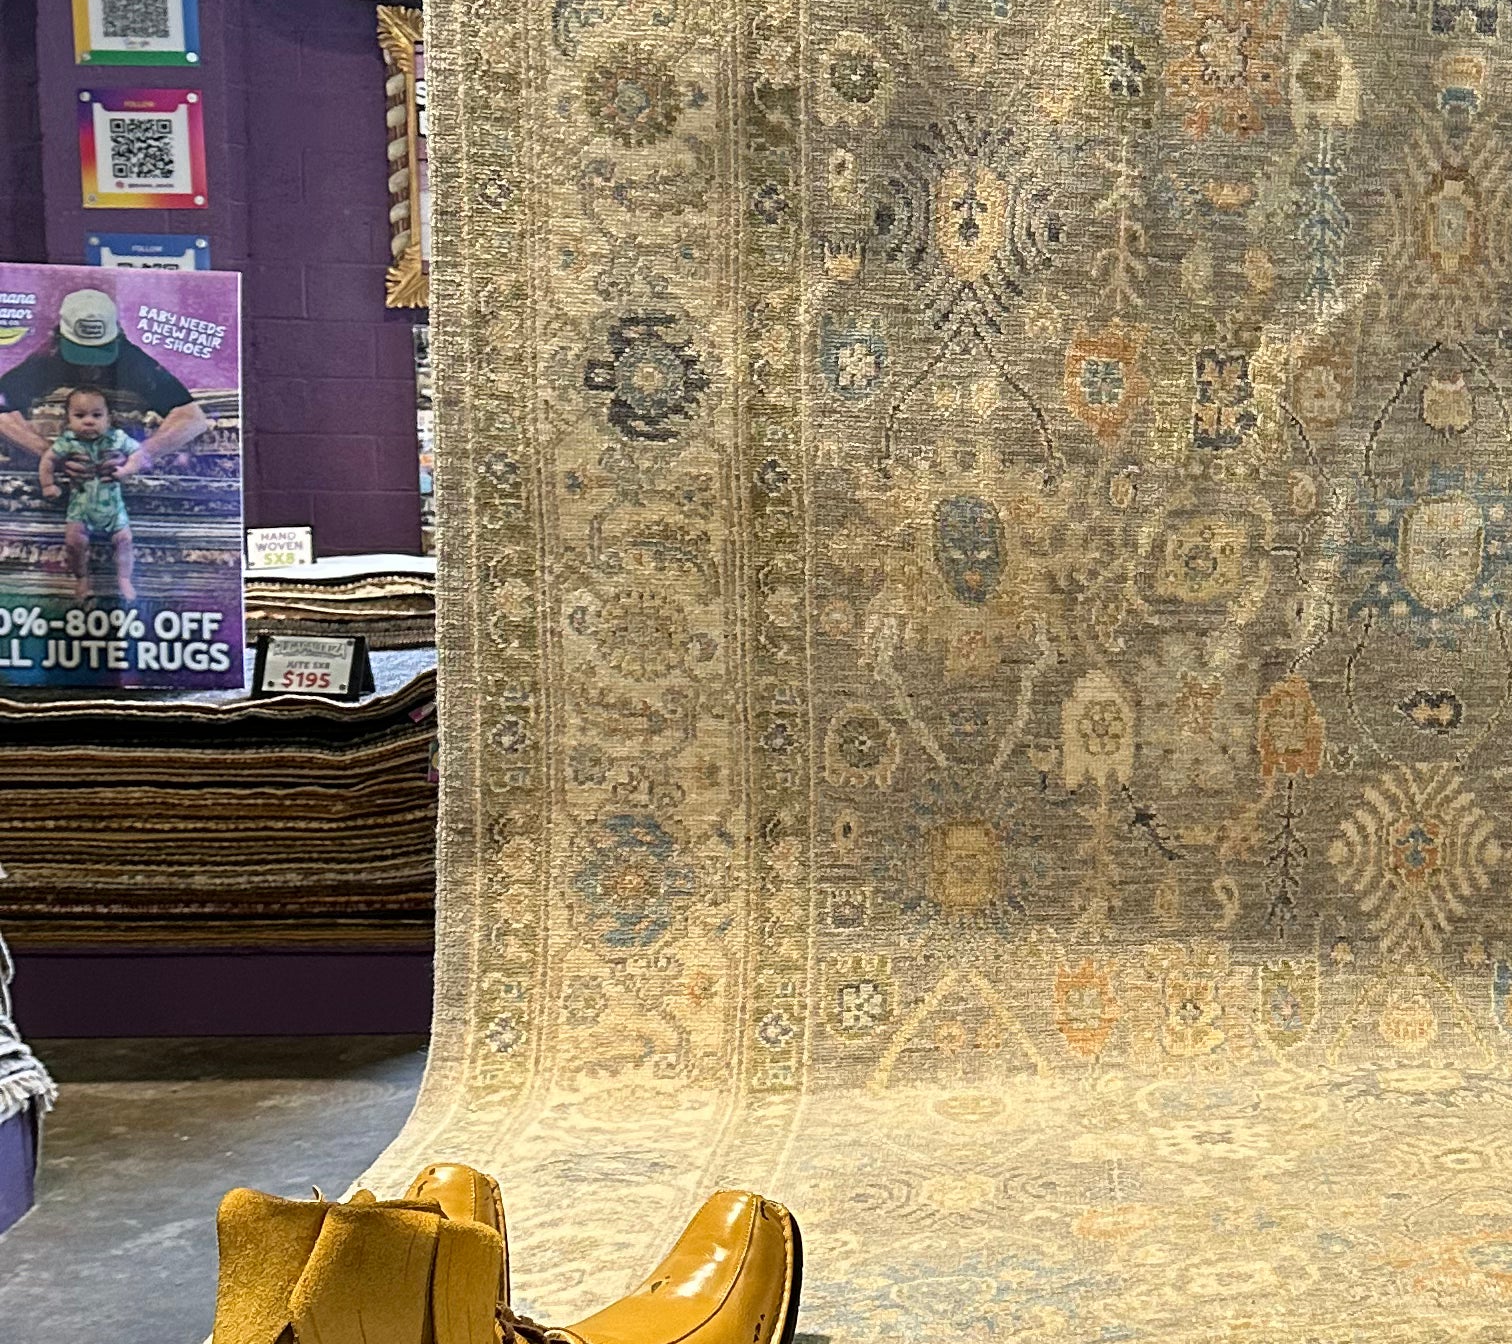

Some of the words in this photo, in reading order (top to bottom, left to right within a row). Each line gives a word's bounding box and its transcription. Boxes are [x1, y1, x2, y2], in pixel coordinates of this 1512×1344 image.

[137, 318, 149, 330] A
[152, 322, 187, 339] NEW
[188, 331, 222, 349] PAIR
[138, 305, 177, 324] BABY
[179, 316, 227, 337] NEEDS
[142, 332, 162, 345] OF
[164, 337, 213, 359] SHOES
[255, 541, 304, 552] WOVEN
[260, 531, 297, 541] HAND
[154, 611, 223, 640] OFF
[41, 639, 130, 669] JUTE
[137, 641, 230, 672] RUGS
[281, 669, 332, 688] $195
